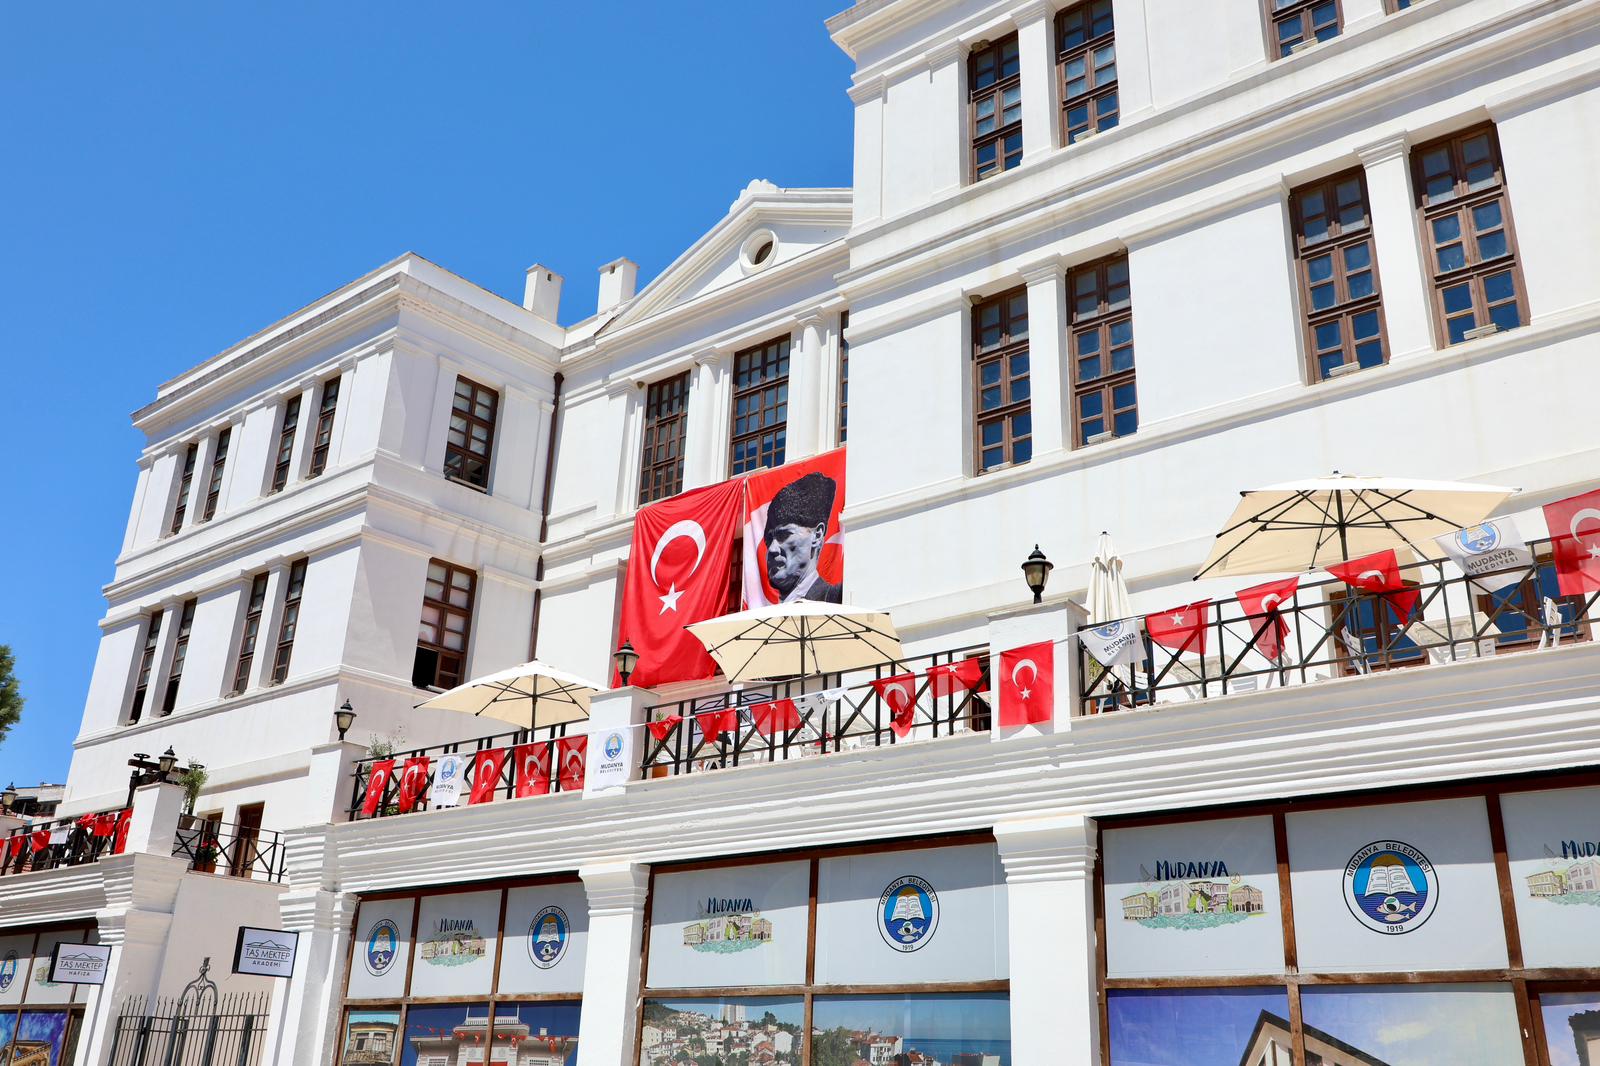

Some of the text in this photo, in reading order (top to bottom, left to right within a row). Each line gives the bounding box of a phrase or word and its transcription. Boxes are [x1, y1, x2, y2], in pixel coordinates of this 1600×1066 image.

[1468, 549, 1515, 571] MUDANYA
[1103, 632, 1136, 653] MUDANYA
[1155, 860, 1230, 881] MUDANYA
[1347, 845, 1379, 878] MUDANYA
[707, 897, 753, 914] MUDANYA
[245, 948, 291, 960] TAŞ MEKTEP
[60, 960, 104, 970] TAŞ MEKTEP
